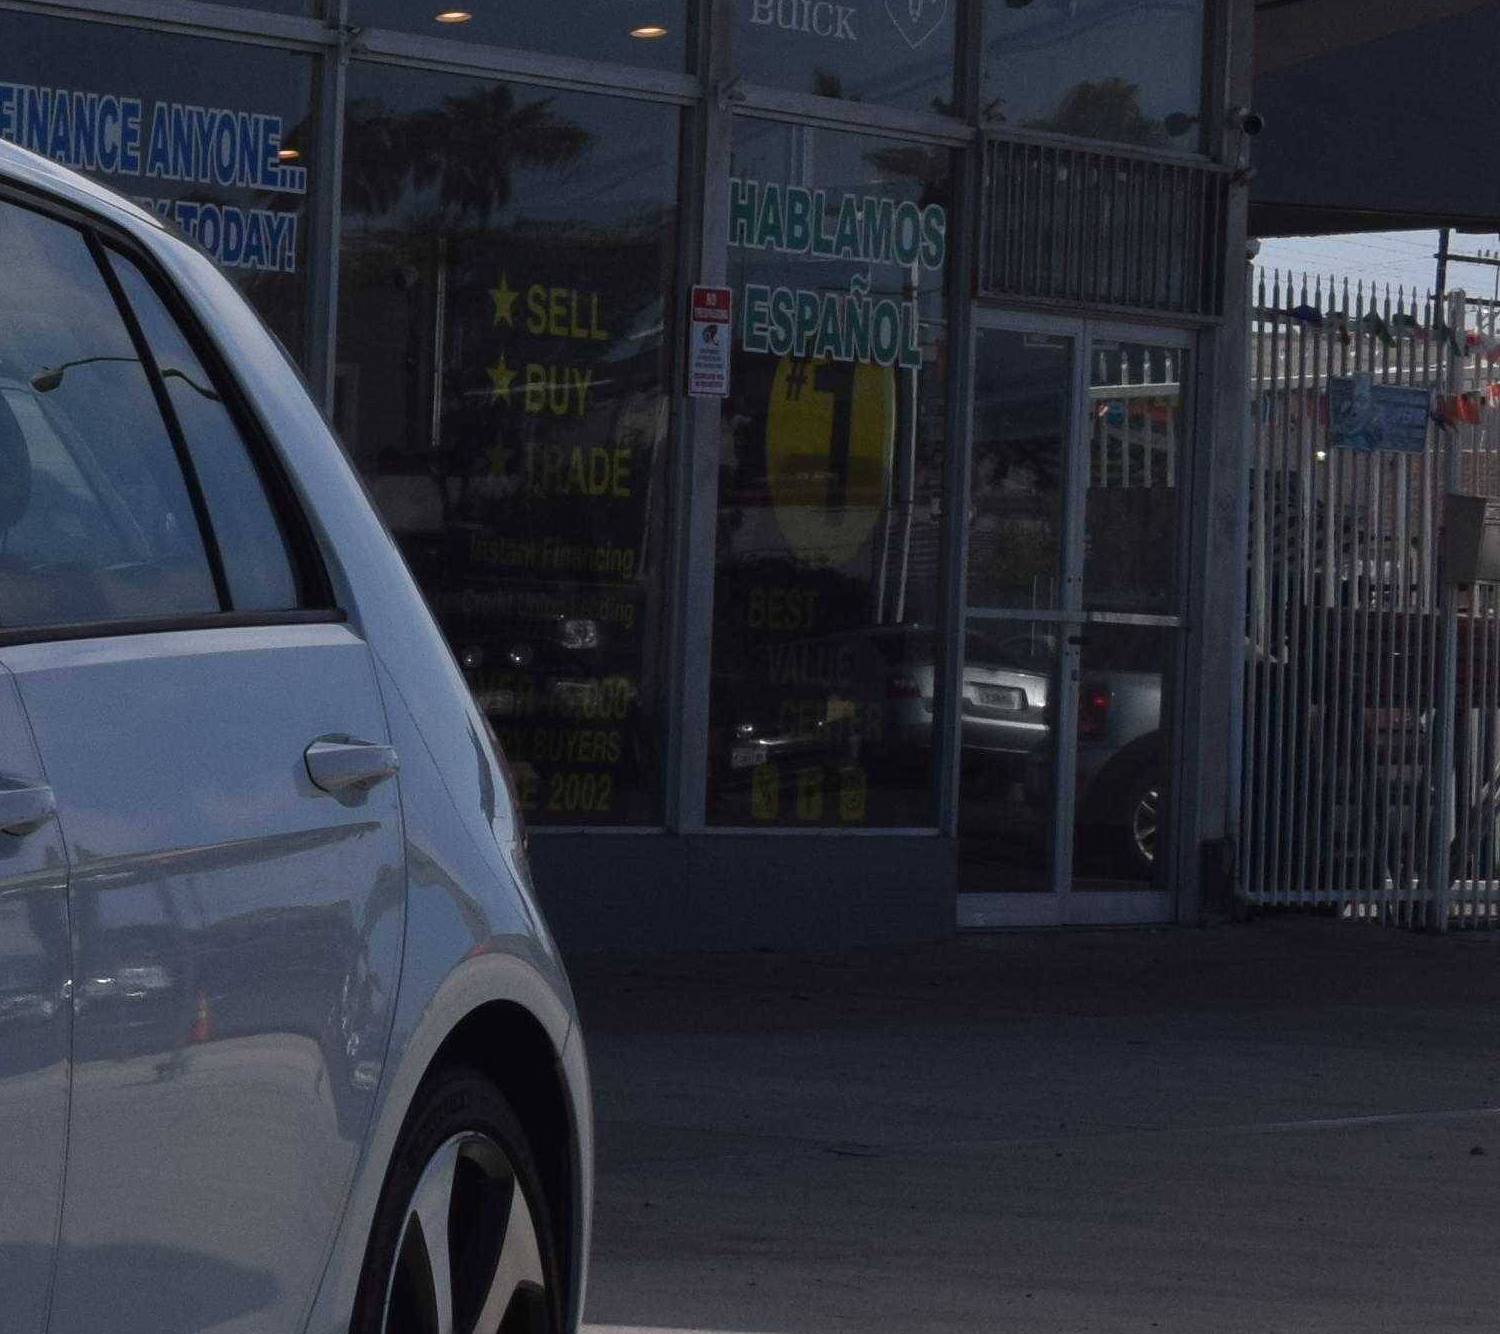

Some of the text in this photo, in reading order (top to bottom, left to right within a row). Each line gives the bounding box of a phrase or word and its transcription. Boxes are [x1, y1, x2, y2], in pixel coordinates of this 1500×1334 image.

[147, 100, 308, 194] ANYONE...
[726, 177, 947, 271] HABLAMOS
[525, 283, 609, 341] SELL
[743, 273, 923, 371] ESPAÑOL
[524, 363, 595, 419] BUY
[522, 441, 633, 500] TRADE
[747, 586, 820, 631] BEST
